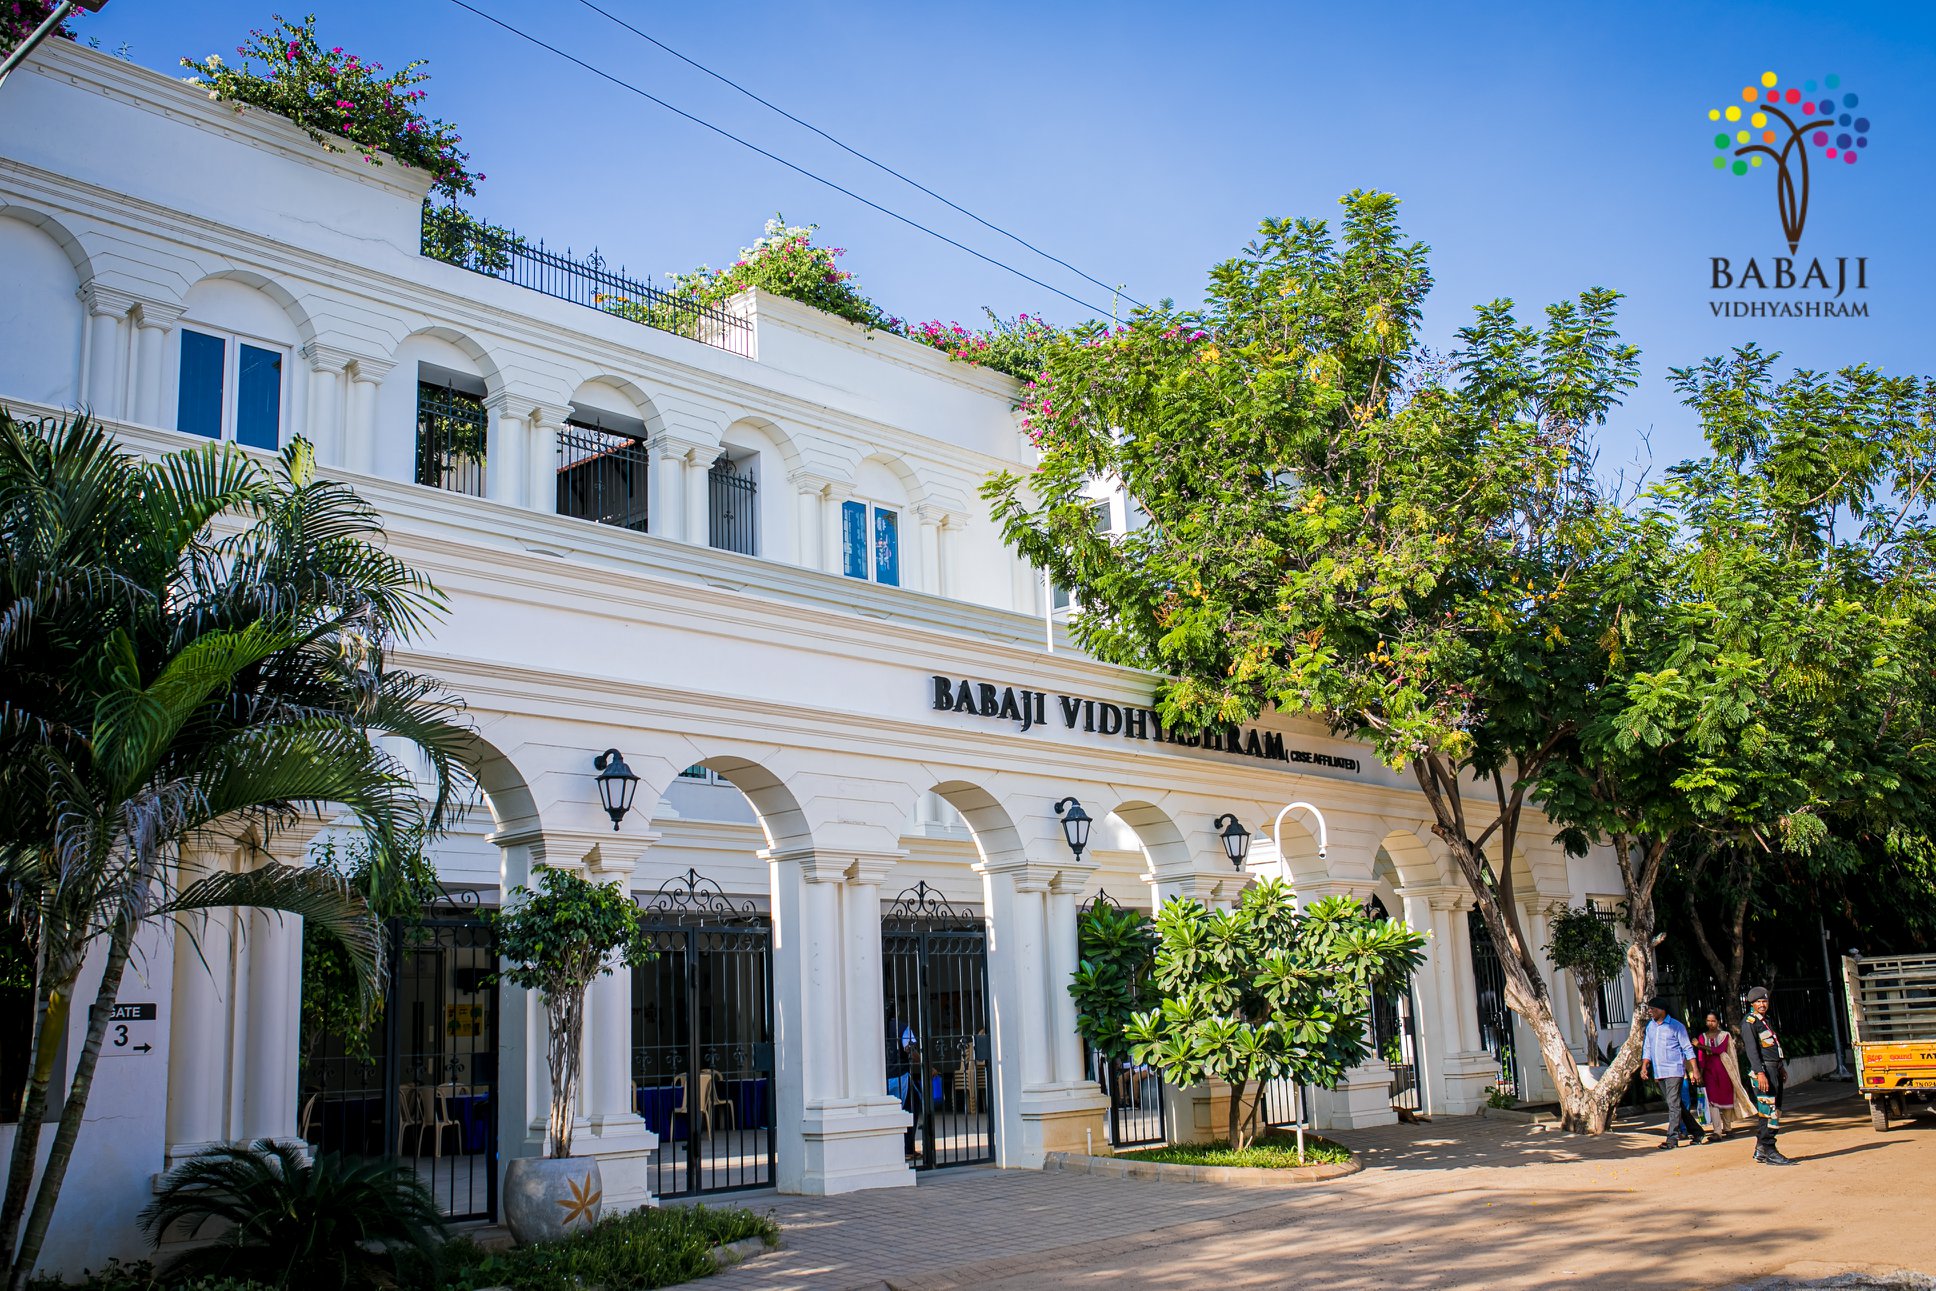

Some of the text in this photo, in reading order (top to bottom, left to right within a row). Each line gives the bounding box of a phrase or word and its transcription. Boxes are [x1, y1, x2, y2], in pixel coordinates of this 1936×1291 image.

[932, 674, 1048, 733] BABAJI
[1058, 695, 1287, 761] VIDHYHRAM
[113, 1024, 129, 1047] 3
